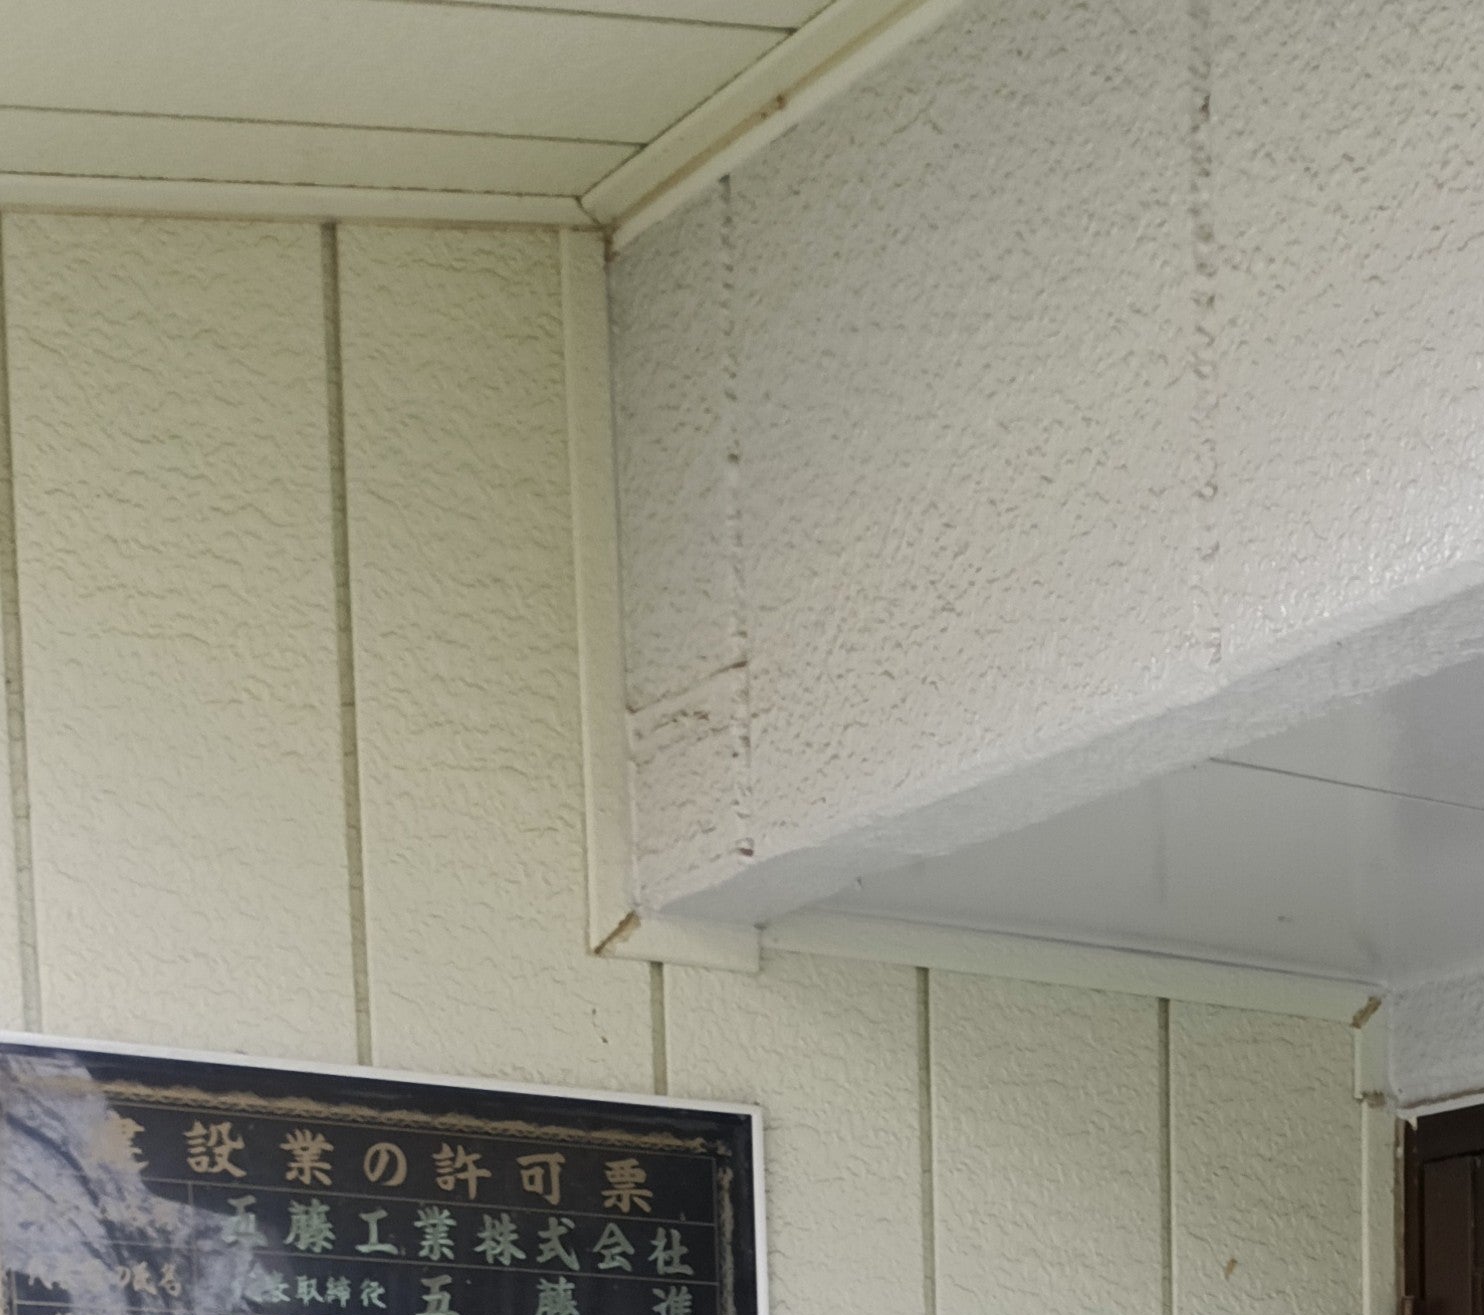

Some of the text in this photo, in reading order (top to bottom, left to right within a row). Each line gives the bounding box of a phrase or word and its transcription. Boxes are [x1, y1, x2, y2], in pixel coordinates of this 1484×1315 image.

[220, 1194, 695, 1276] 五藤工業株式会社
